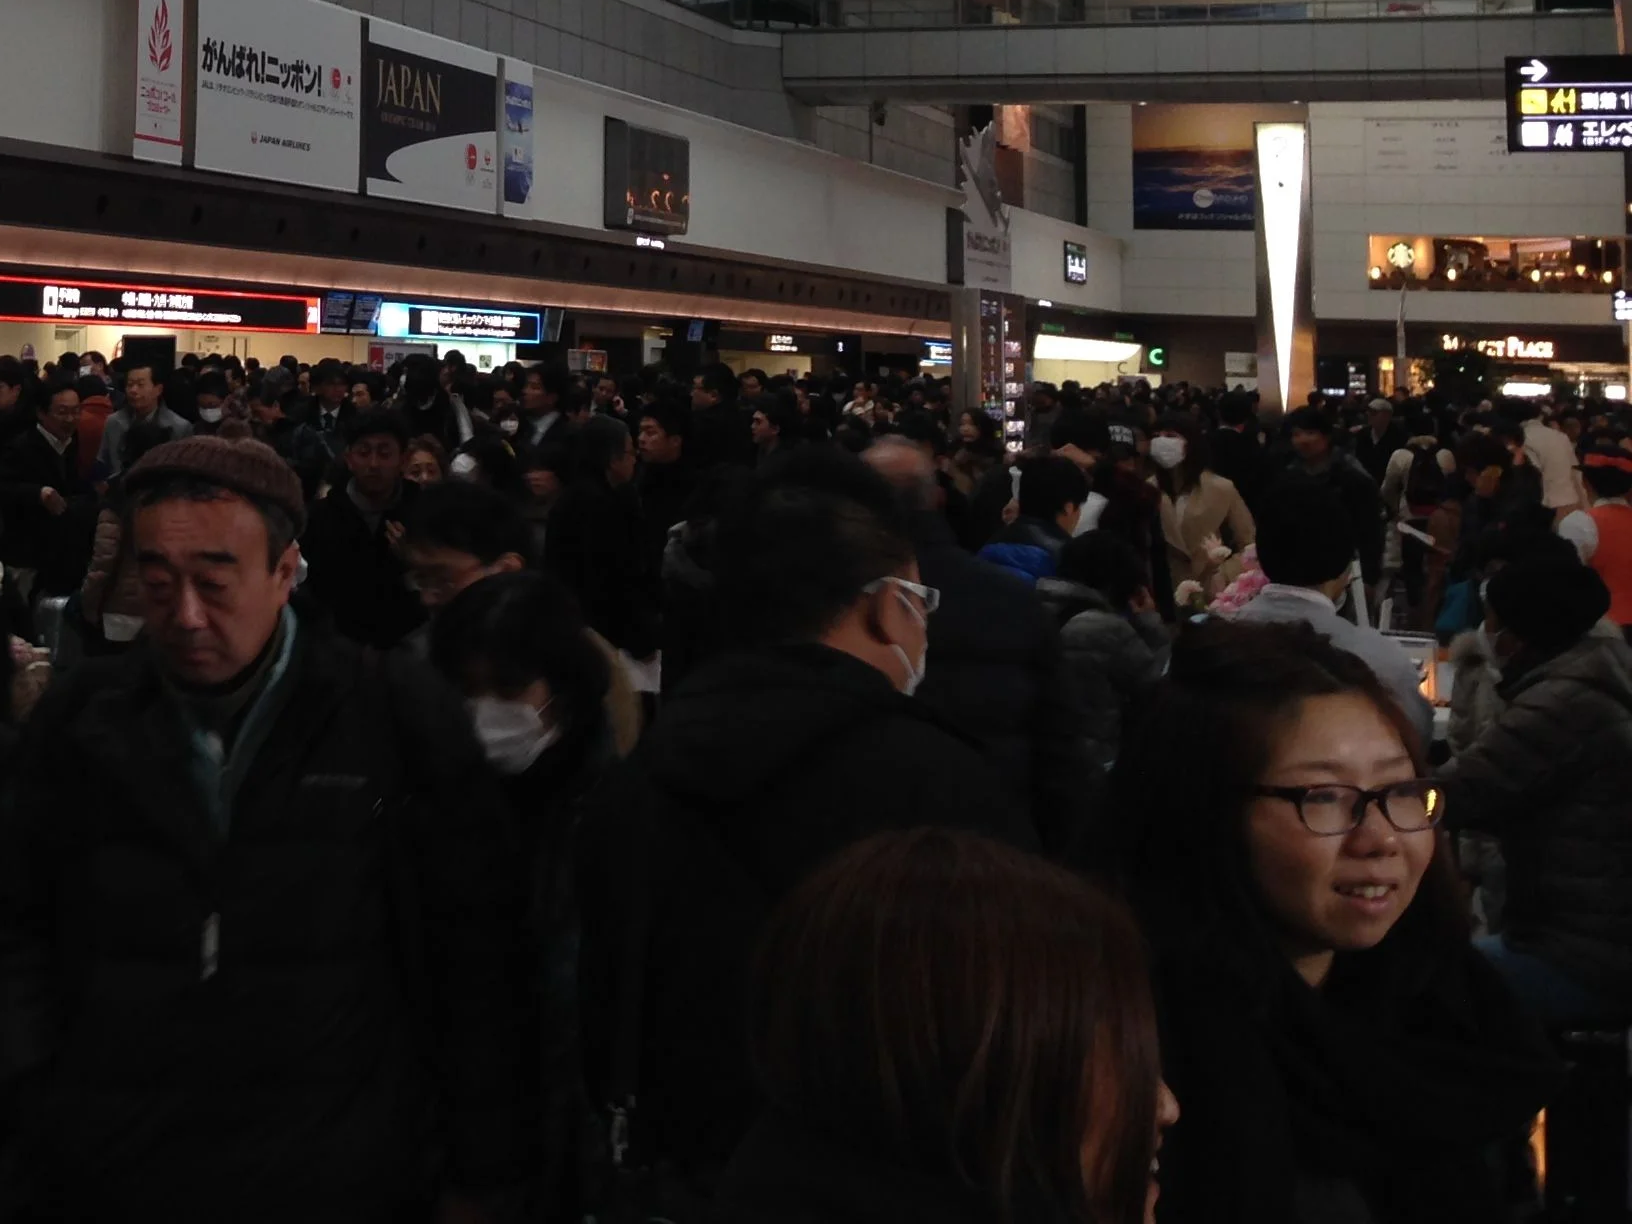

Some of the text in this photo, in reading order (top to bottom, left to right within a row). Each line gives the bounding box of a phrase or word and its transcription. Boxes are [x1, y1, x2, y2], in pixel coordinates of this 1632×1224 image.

[377, 59, 441, 115] JAPAN
[259, 134, 311, 152] JAPAN AIRLINES
[1148, 347, 1164, 365] C
[1507, 336, 1554, 358] PLACE
